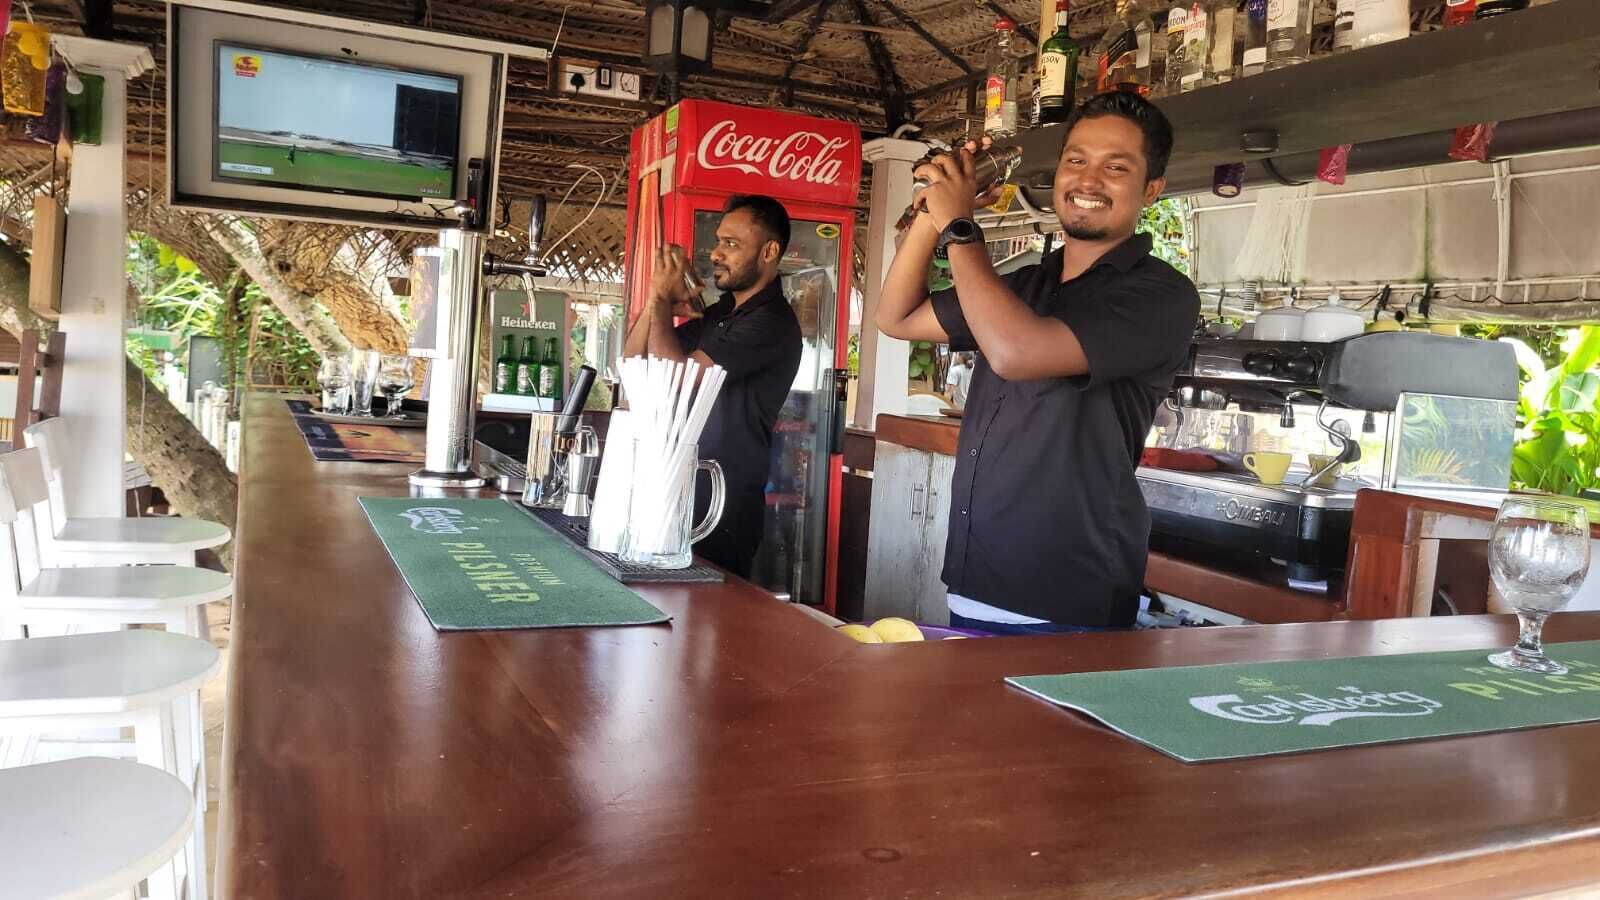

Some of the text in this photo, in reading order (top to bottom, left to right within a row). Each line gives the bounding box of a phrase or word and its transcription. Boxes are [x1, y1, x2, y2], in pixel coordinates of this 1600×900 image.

[697, 120, 850, 185] Coca-Cola
[501, 316, 557, 330] Heineken
[440, 542, 541, 603] PILSNER
[510, 553, 566, 585] PREMIUM
[1188, 690, 1442, 727] Carlsberg
